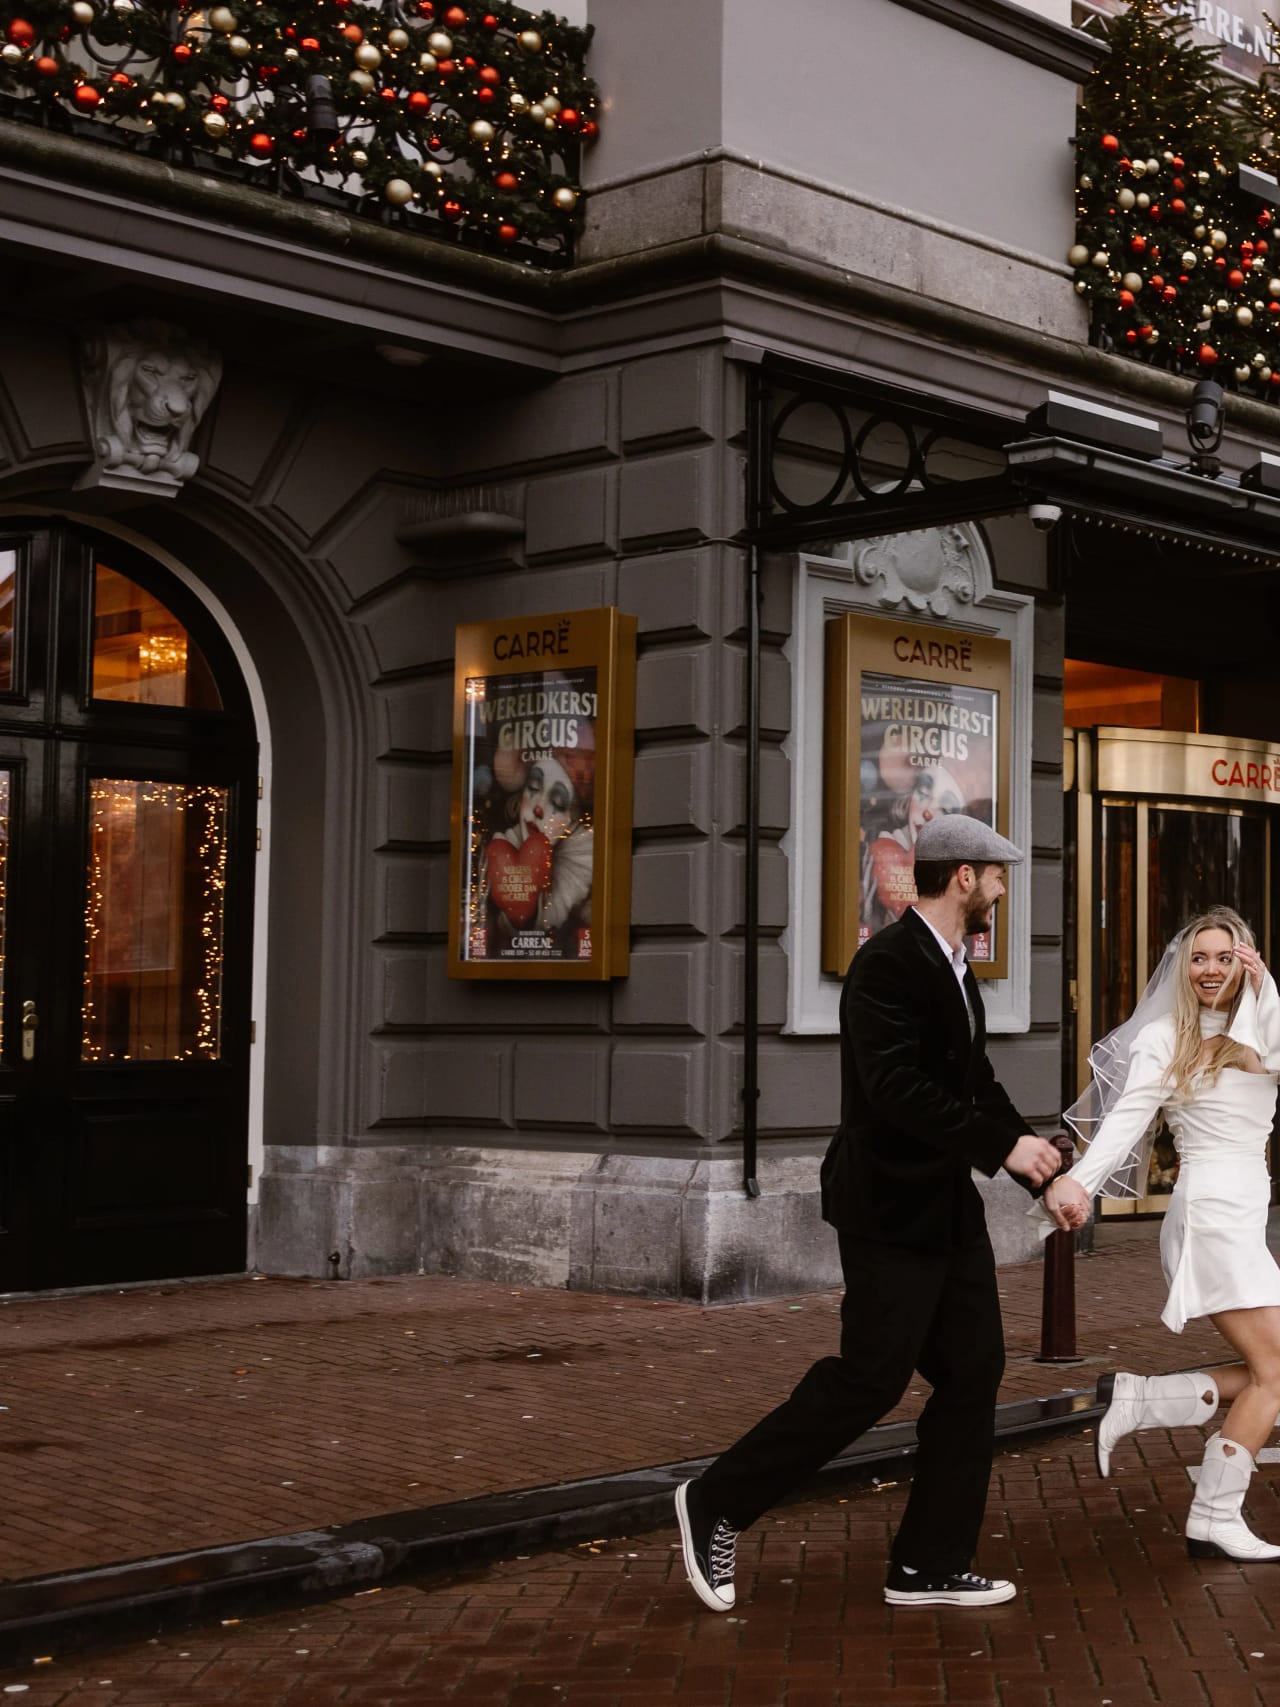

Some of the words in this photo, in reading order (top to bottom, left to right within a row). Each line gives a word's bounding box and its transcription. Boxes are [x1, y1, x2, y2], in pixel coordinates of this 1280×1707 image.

[480, 691, 598, 724] WERELDKERST
[861, 697, 991, 737] WERELDKERST
[499, 718, 579, 750] CIRCUS
[883, 723, 969, 761] CIRCUS
[583, 929, 590, 939] 5
